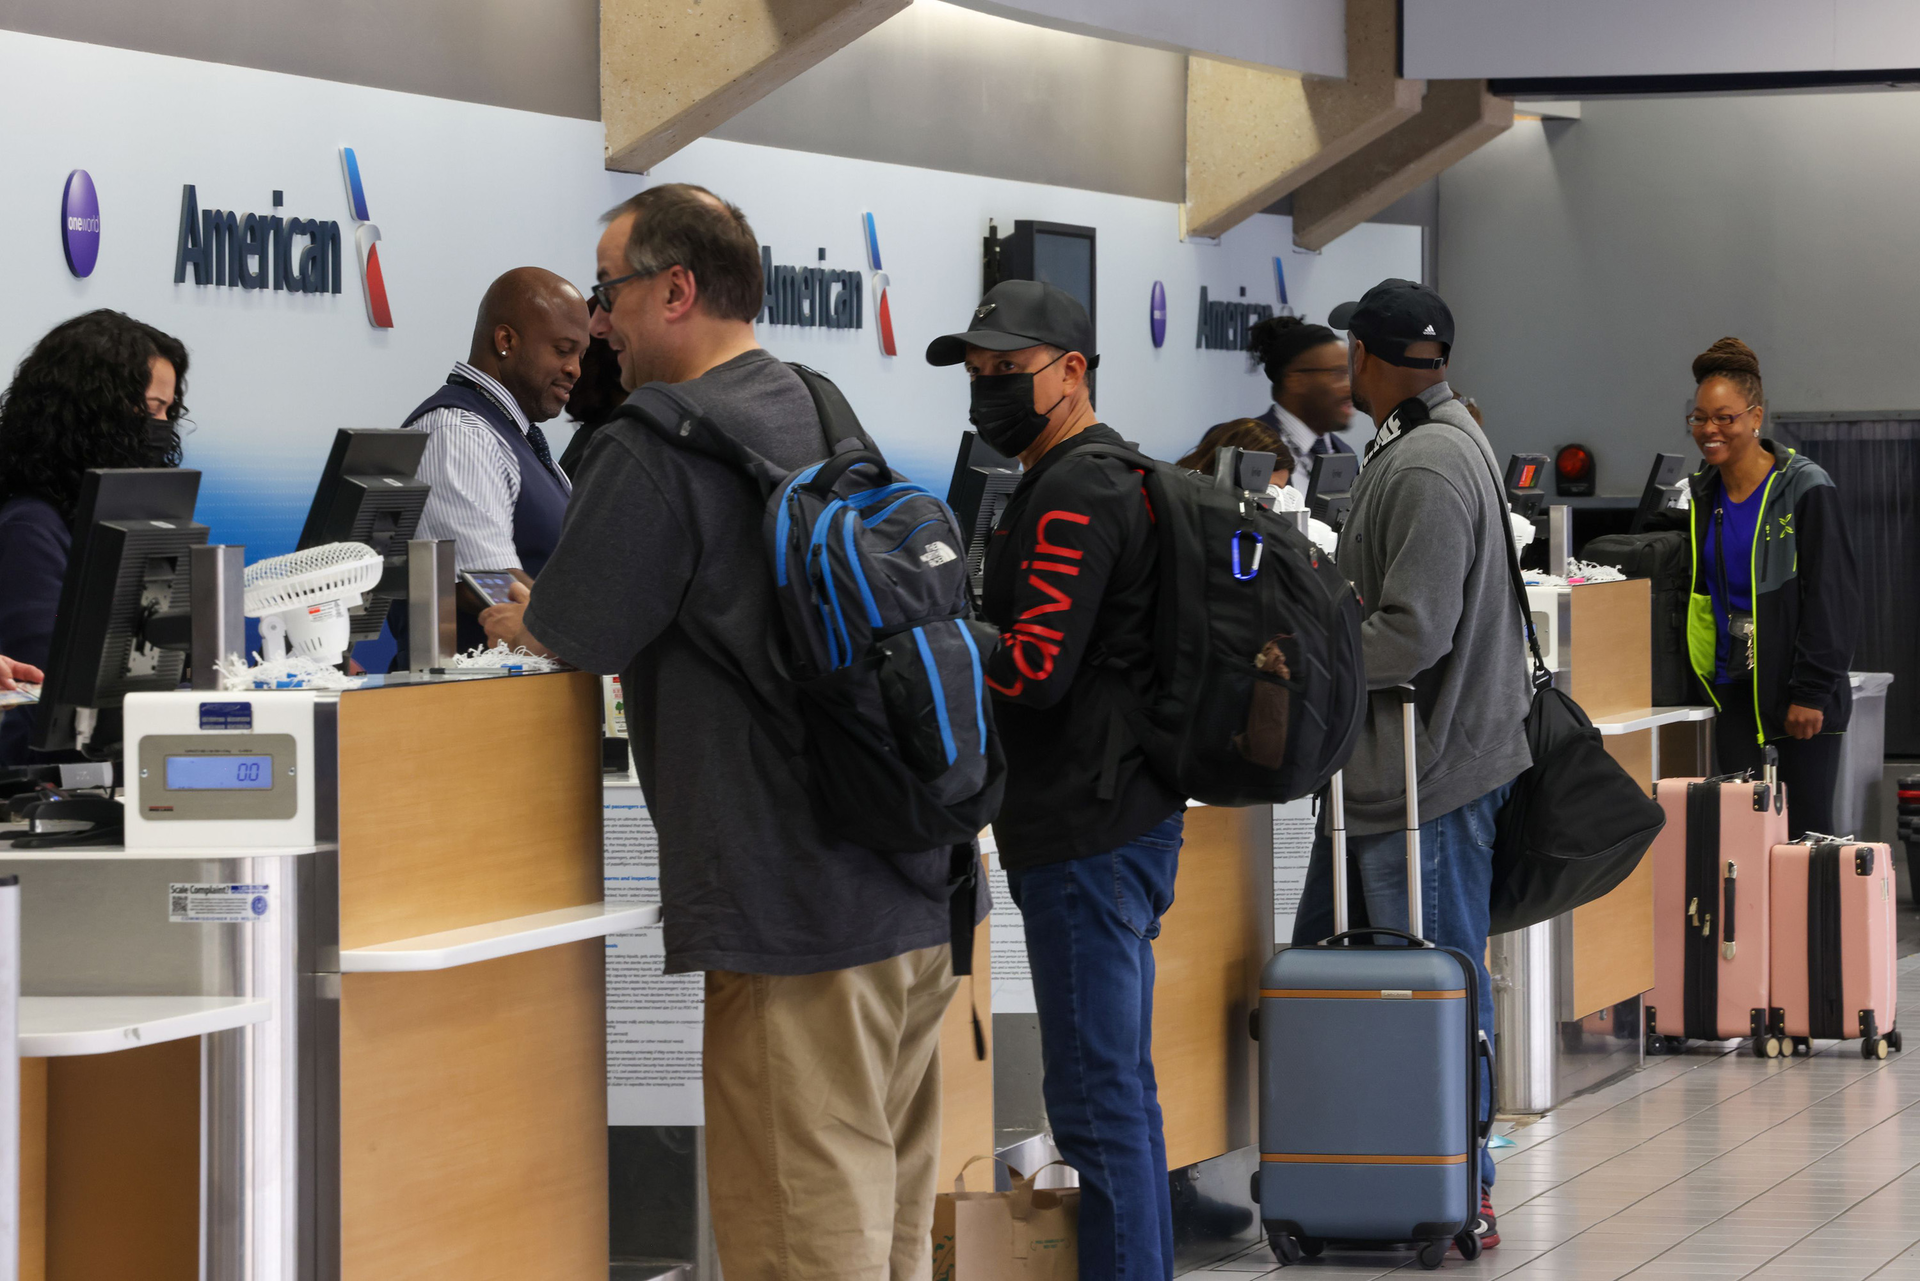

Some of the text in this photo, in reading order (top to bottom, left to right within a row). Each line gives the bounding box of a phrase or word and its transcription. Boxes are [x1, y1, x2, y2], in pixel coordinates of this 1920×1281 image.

[68, 215, 99, 233] oneworld
[174, 184, 341, 294] American
[756, 245, 862, 329] American
[1196, 286, 1273, 352] Americ
[171, 885, 188, 894] Scale
[190, 885, 230, 896] Complaint?
